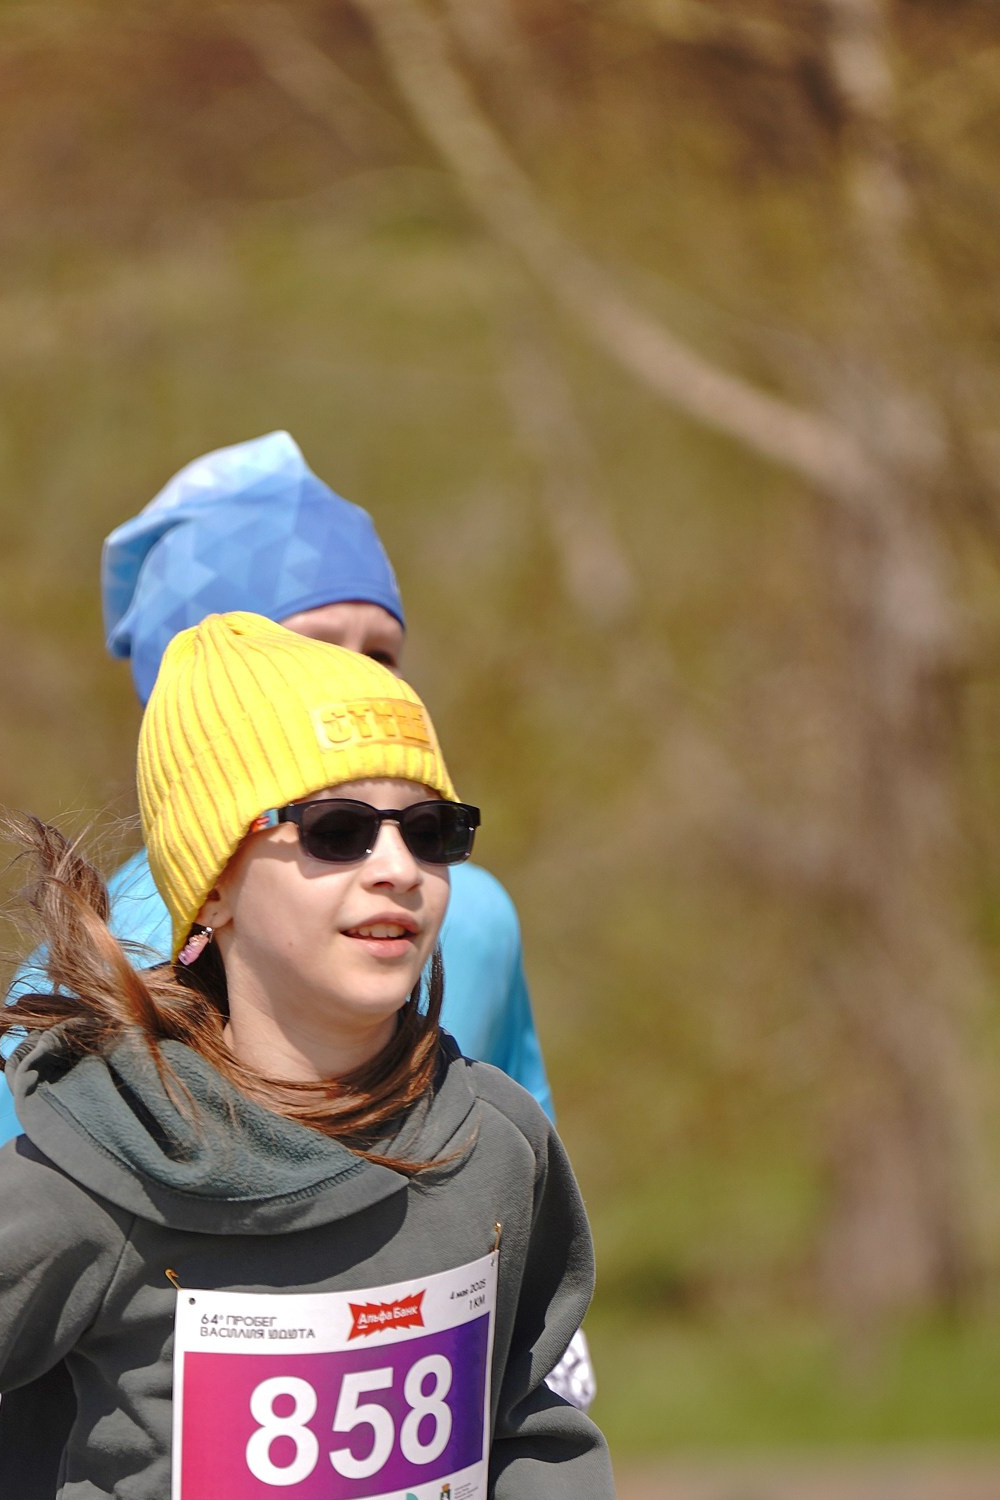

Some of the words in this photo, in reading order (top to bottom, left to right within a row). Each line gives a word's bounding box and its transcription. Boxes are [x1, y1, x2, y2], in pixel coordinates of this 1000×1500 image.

[226, 1315, 278, 1328] ПРОБЕГ
[356, 1309, 393, 1330] Альфа
[393, 1304, 419, 1319] Банк
[199, 1326, 265, 1340] ВАСИЛИЯ
[246, 1354, 452, 1487] 858
